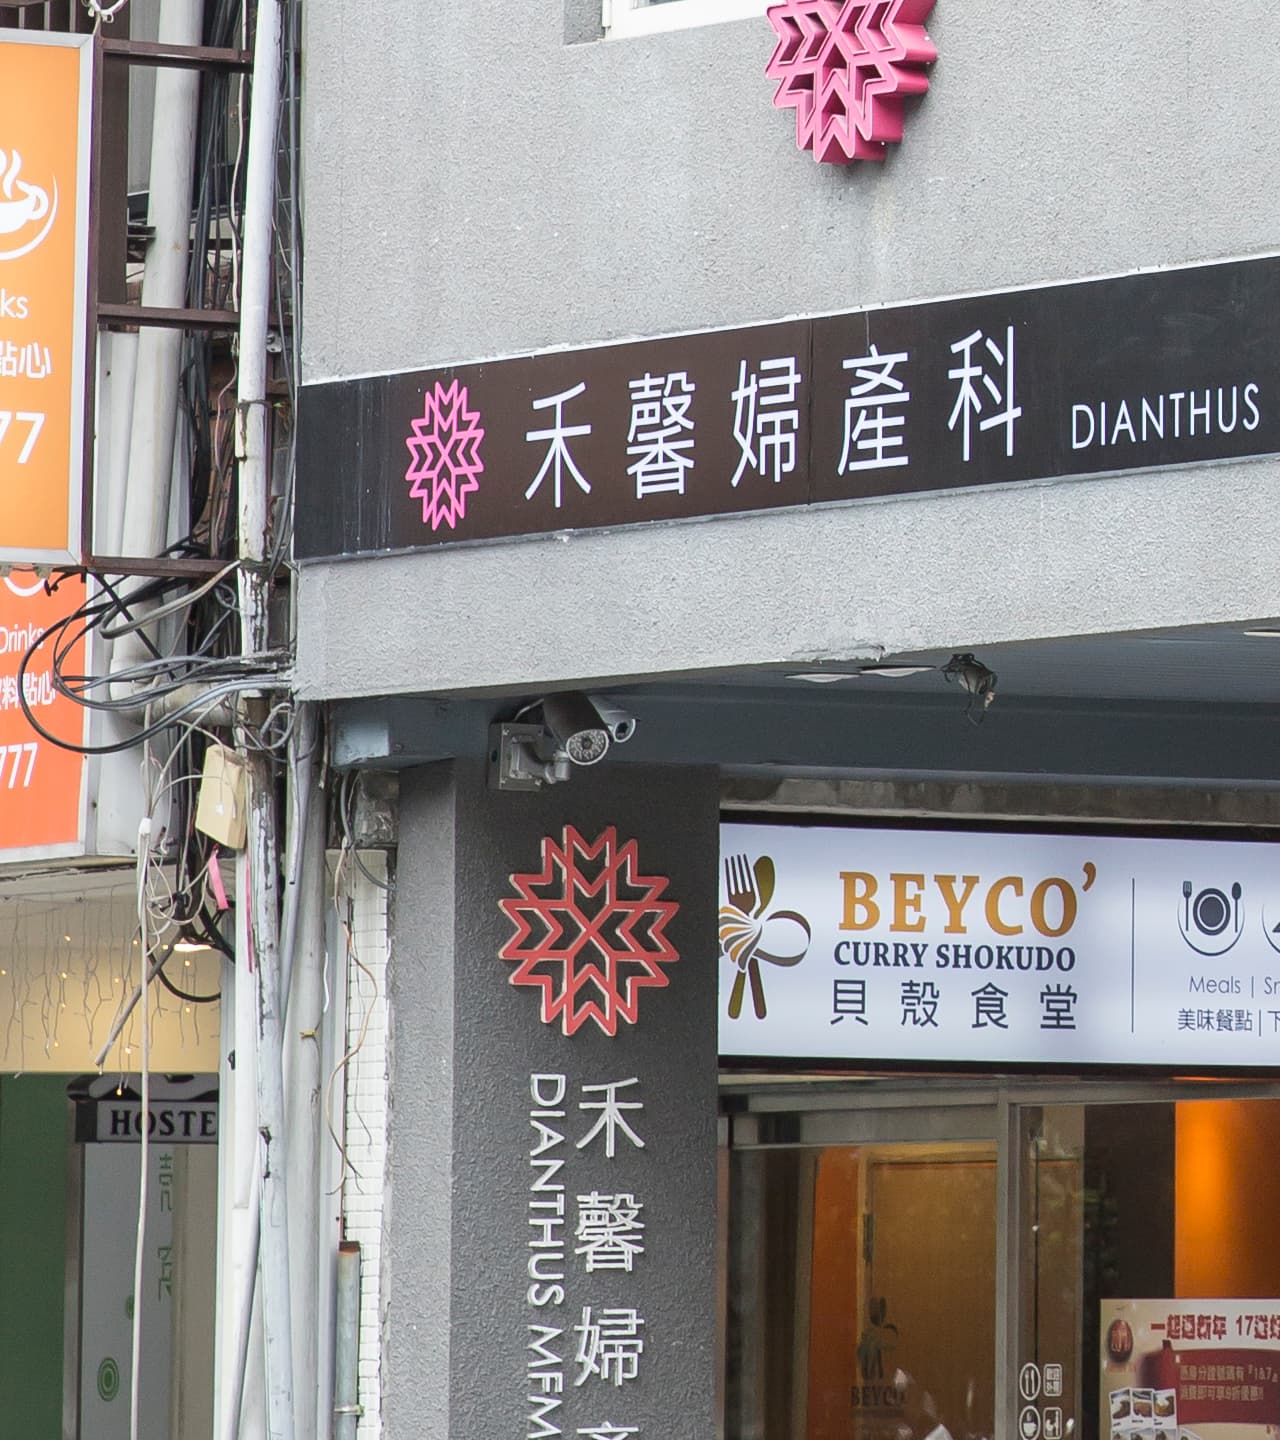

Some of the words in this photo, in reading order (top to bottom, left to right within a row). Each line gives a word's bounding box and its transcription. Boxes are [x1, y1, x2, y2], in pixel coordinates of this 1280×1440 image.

[525, 325, 1022, 508] 禾馨婦產科
[1071, 382, 1260, 450] DIANTHUS
[834, 941, 928, 968] CURRY
[936, 944, 1076, 972] SHOKUDO
[830, 979, 1078, 1030] 貝殼食堂
[1189, 976, 1241, 995] Meals
[1177, 1008, 1253, 1032] 美味餐點
[528, 1073, 566, 1306] DIANTHUS
[527, 1324, 564, 1439] MFM
